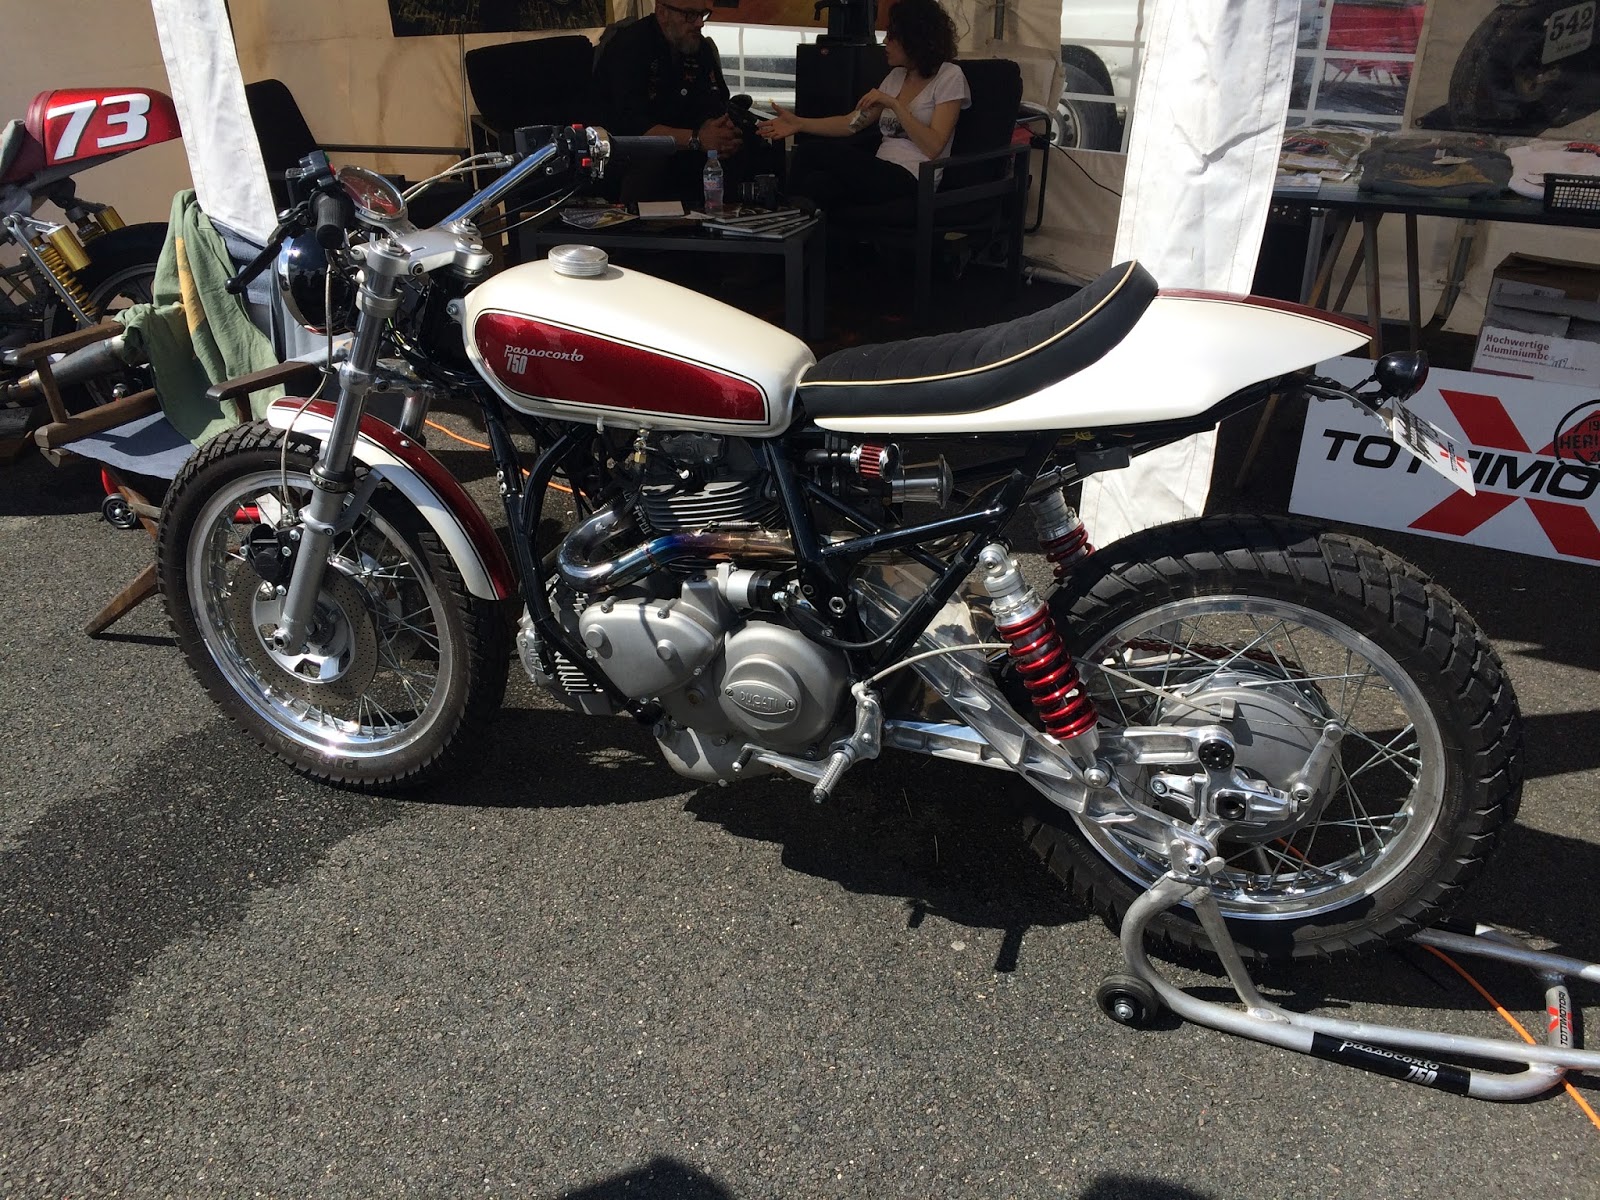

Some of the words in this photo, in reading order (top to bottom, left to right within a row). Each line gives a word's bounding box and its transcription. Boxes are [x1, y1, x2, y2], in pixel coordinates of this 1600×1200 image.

[1549, 6, 1593, 41] 542
[46, 93, 151, 160] 73
[503, 344, 584, 362] passocorto
[1486, 334, 1550, 351] Hochwertige
[506, 353, 528, 375] 750
[740, 691, 779, 709] DUCATI
[1558, 990, 1569, 1046] TOTTIMOTORI
[1338, 1040, 1440, 1070] passocorto
[1404, 1065, 1438, 1086] 750
